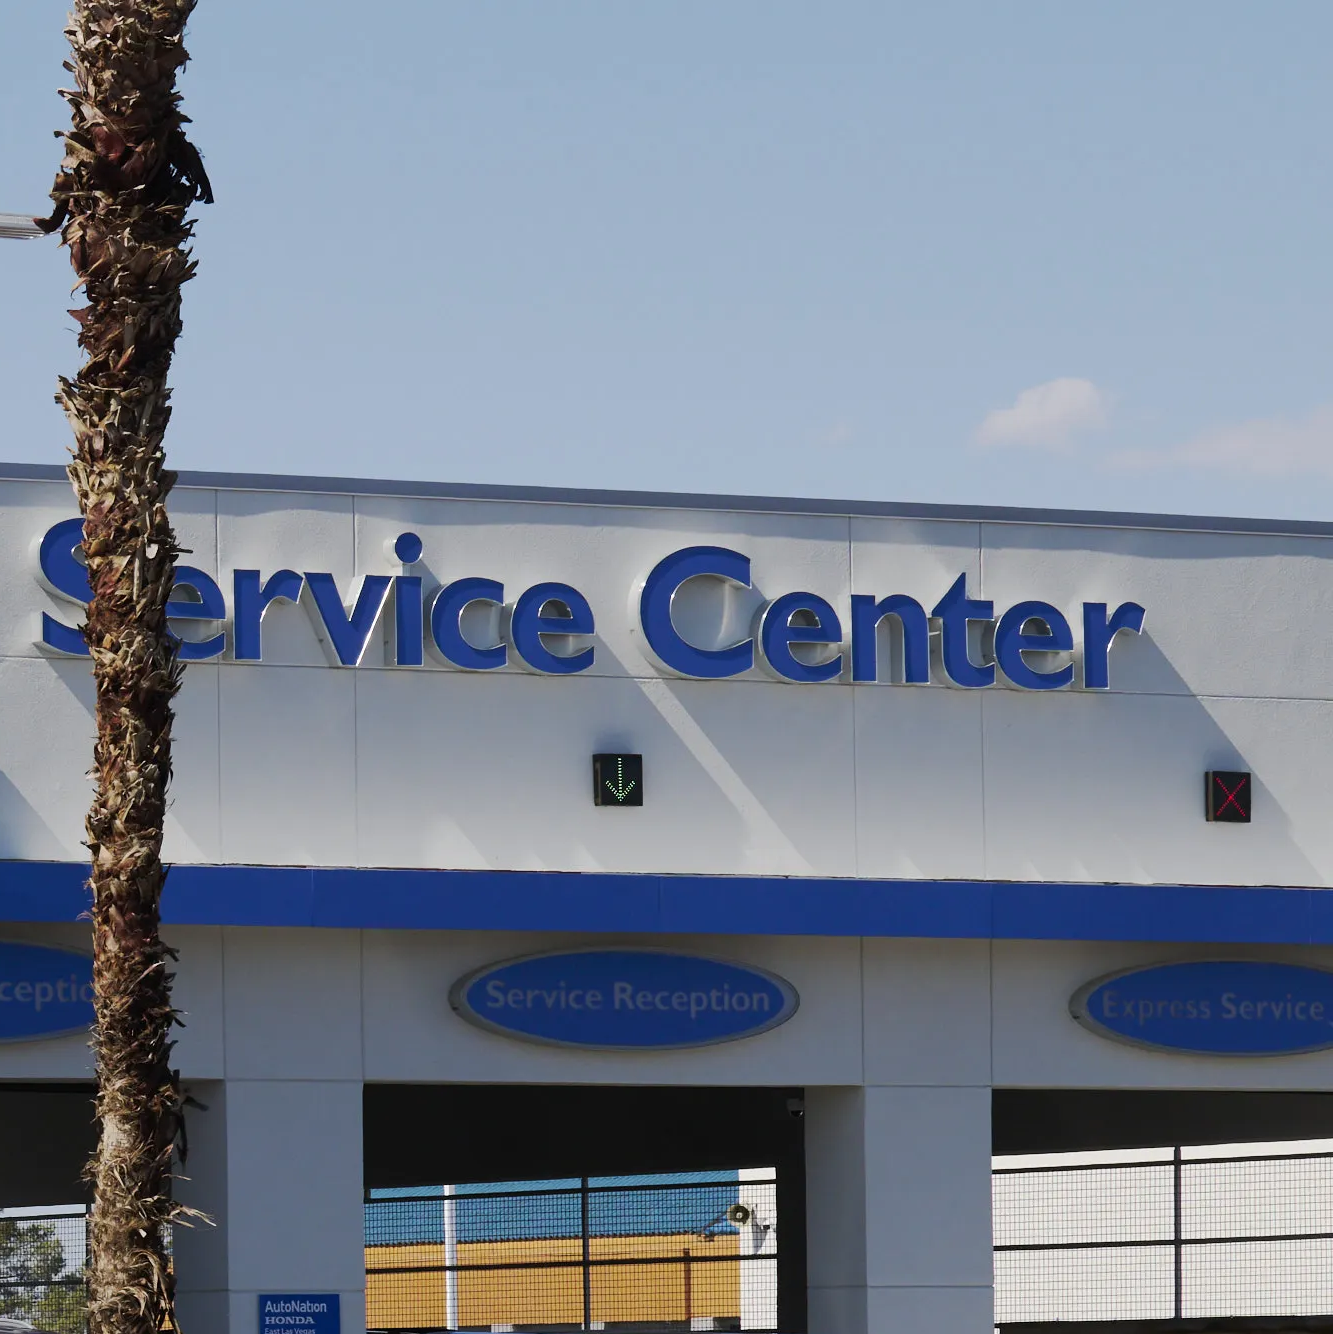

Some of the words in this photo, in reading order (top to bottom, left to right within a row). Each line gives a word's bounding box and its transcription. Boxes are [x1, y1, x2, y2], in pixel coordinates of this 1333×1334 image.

[636, 545, 1145, 692] Center
[485, 979, 603, 1010] Service
[613, 981, 770, 1020] Reception
[1102, 990, 1211, 1027] Express
[1220, 992, 1325, 1021] Service
[264, 1316, 316, 1325] HONDA
[265, 1300, 327, 1313] AutoNation
